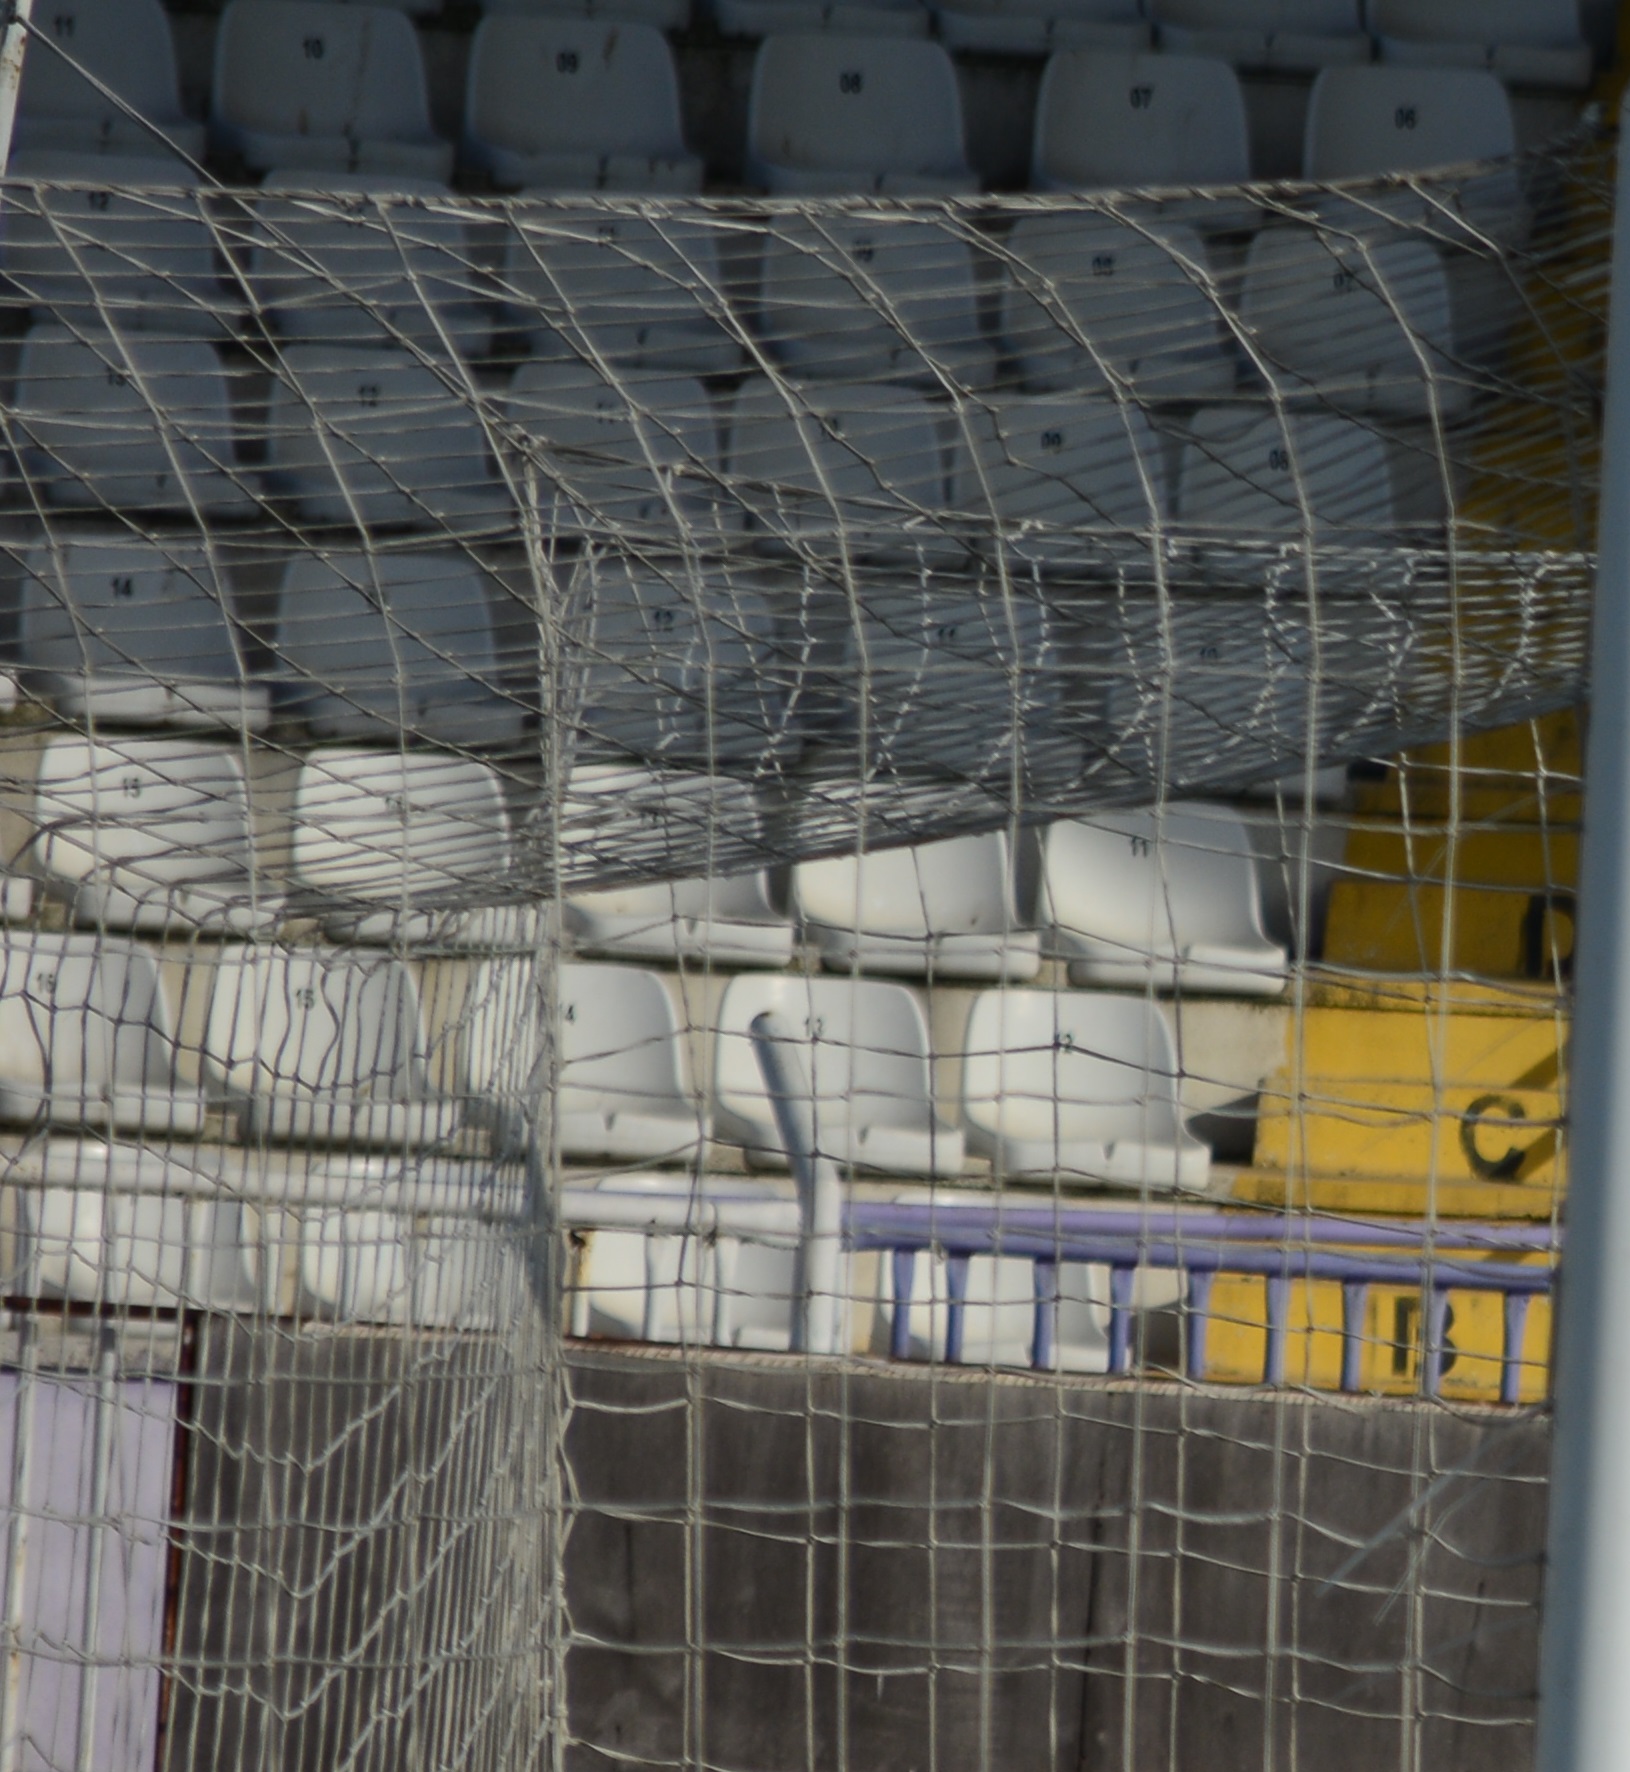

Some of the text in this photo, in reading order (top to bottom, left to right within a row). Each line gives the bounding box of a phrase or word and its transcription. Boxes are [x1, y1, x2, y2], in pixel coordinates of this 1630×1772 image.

[54, 15, 75, 36] 11
[303, 38, 324, 60] 10
[1130, 86, 1154, 110] 07
[1460, 1095, 1526, 1182] C
